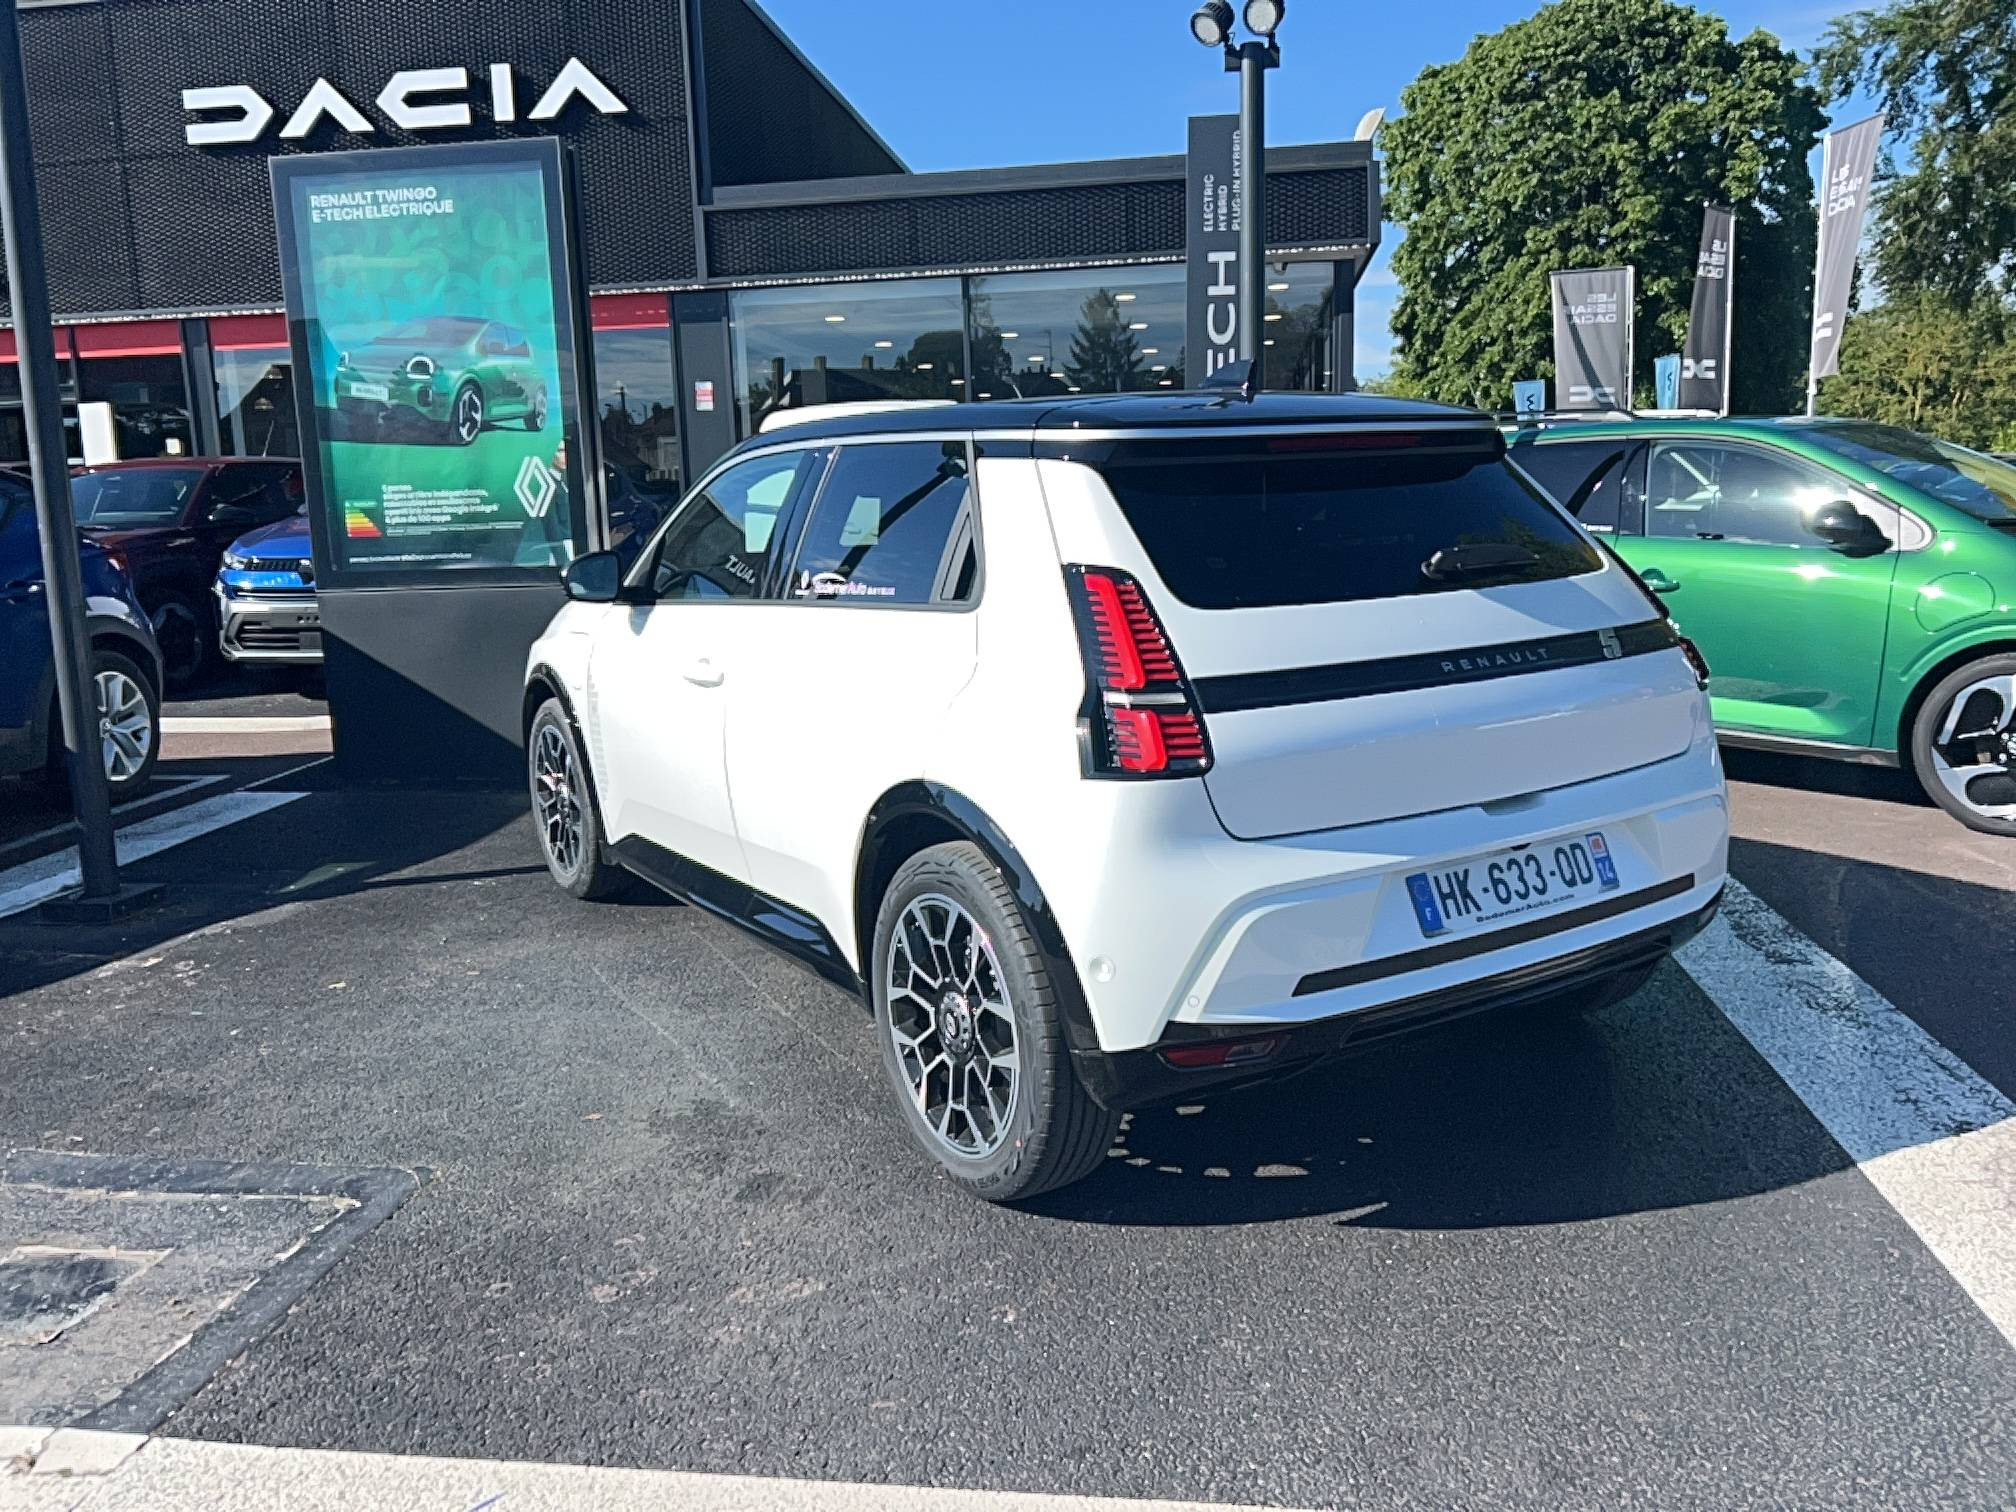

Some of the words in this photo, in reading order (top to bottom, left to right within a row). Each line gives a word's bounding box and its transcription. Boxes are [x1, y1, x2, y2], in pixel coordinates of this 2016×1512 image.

[182, 57, 629, 146] DACIA
[310, 191, 374, 208] RENAULT
[375, 186, 437, 203] TWINGO
[312, 207, 364, 224] E-TECH
[366, 199, 454, 219] ELECTRIQUE
[1203, 174, 1215, 232] ELECTRIC
[1217, 185, 1228, 232] HYBRID
[1440, 648, 1550, 673] RENAULT
